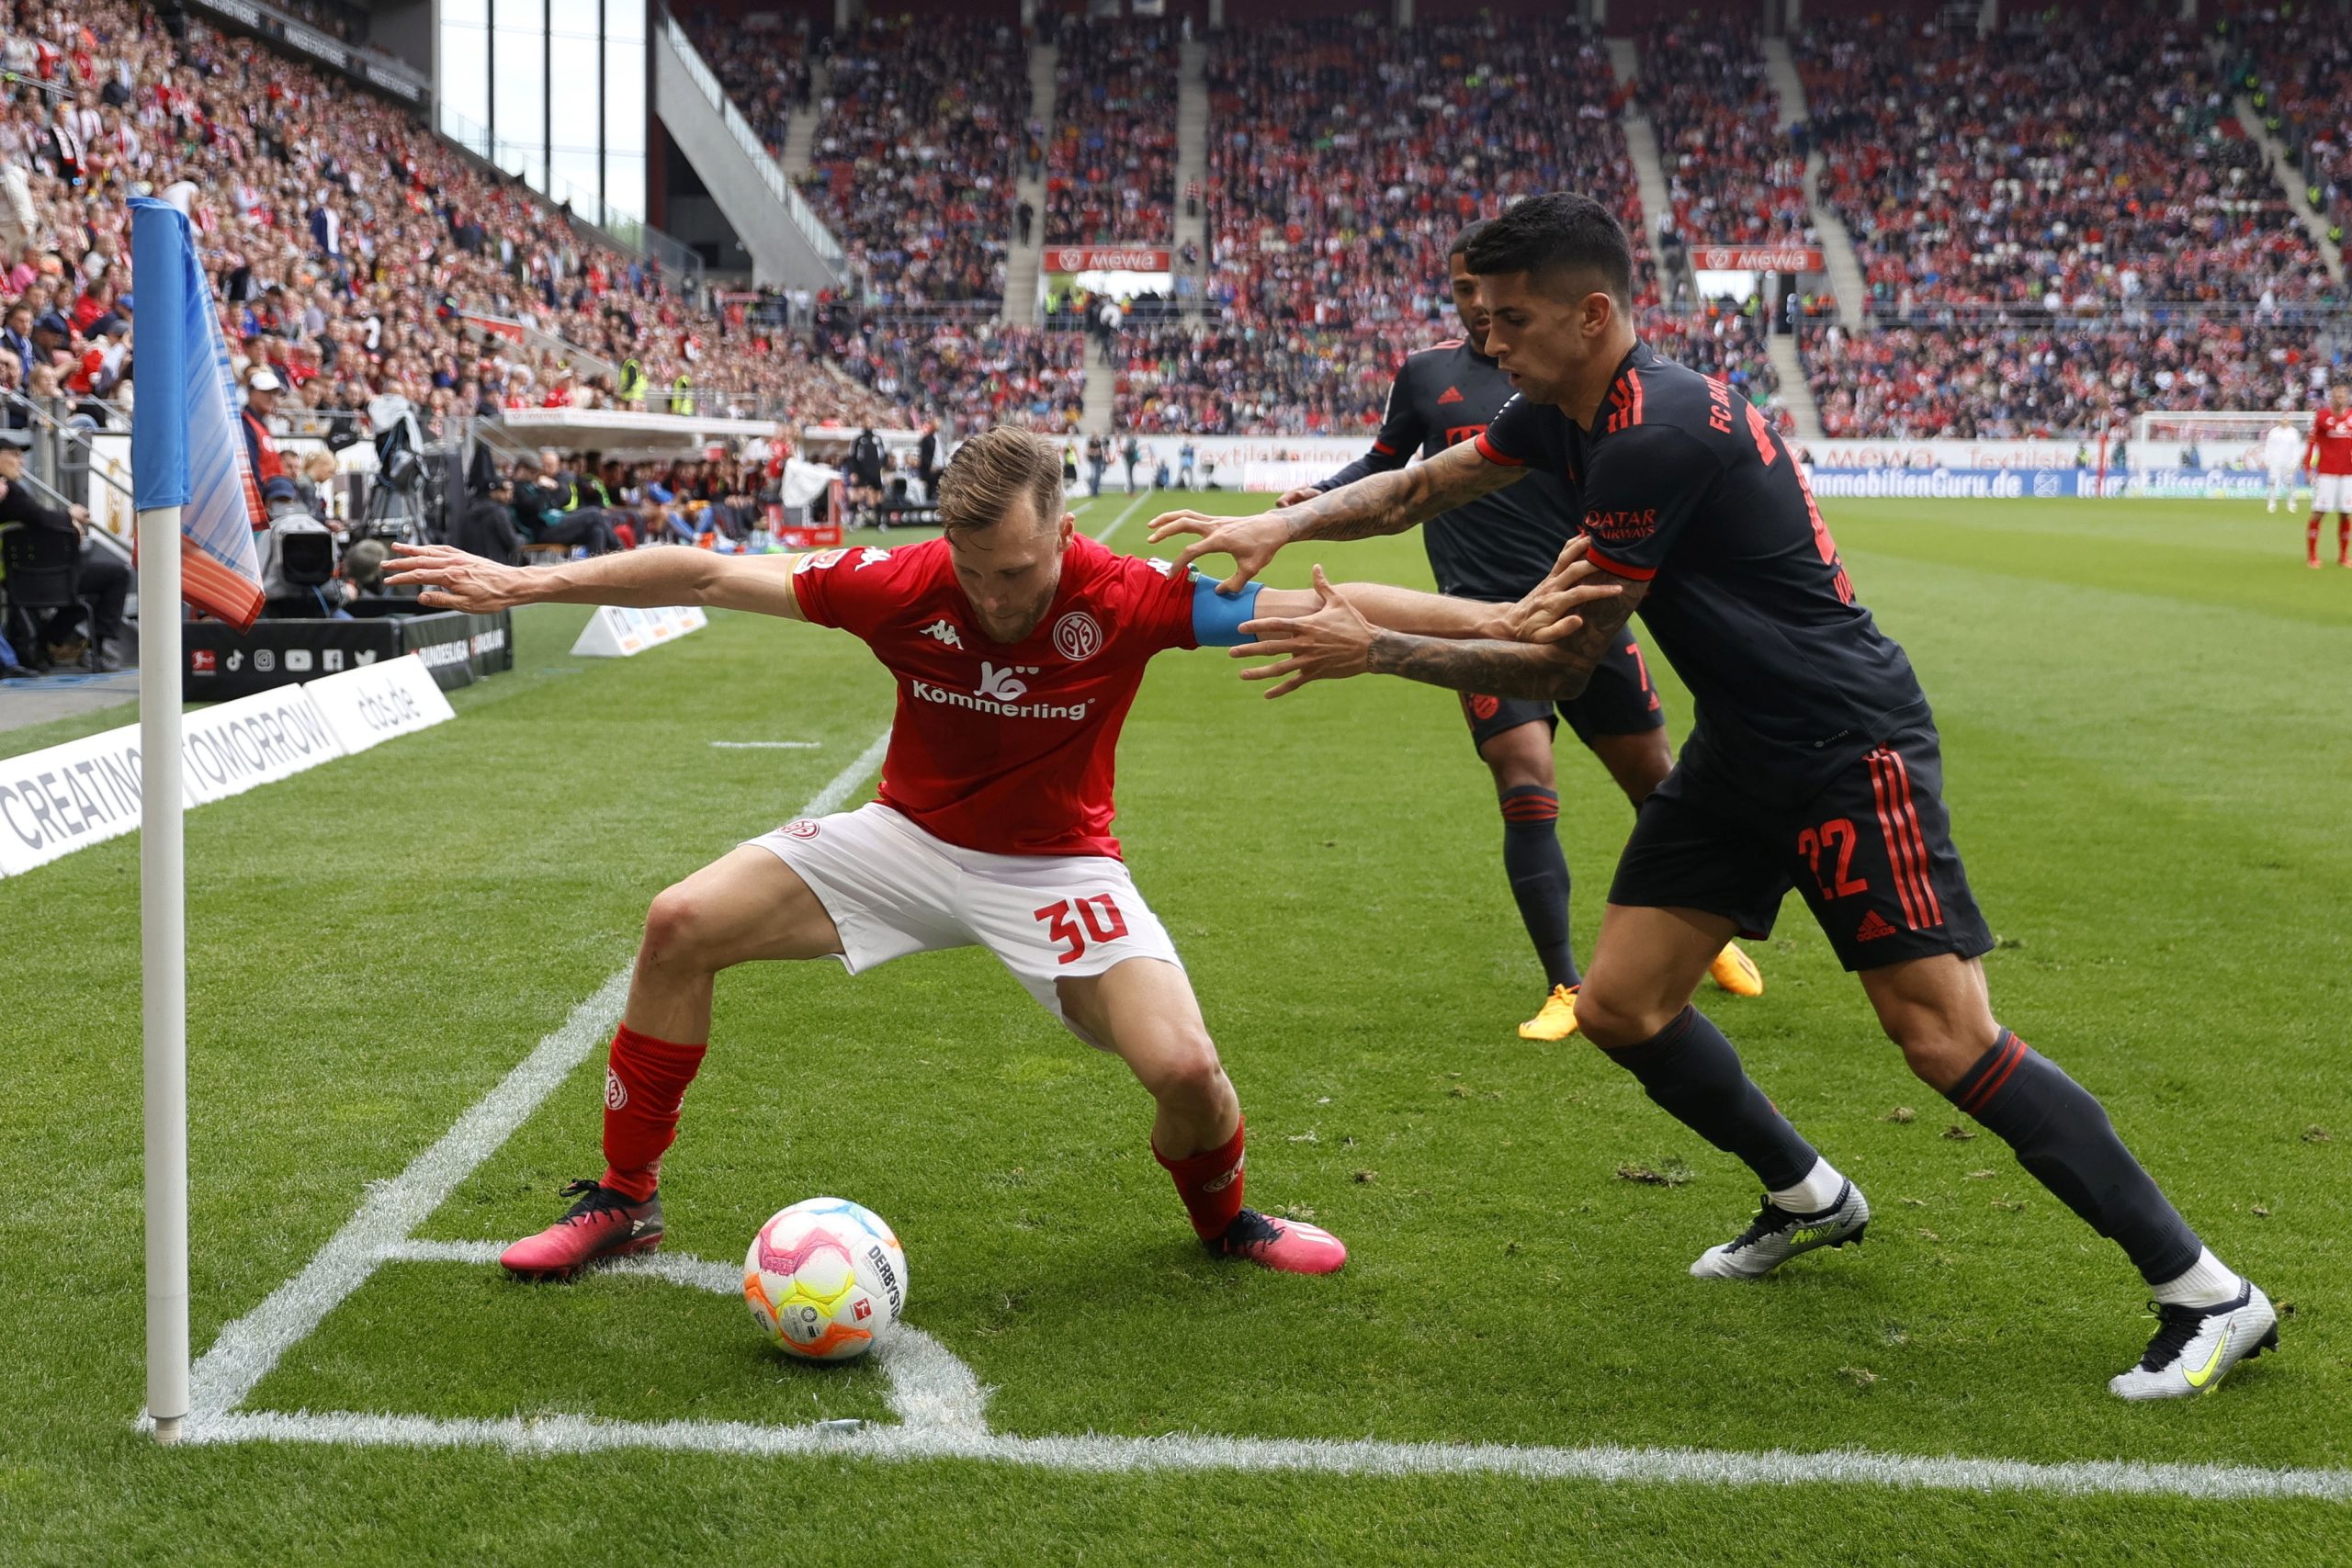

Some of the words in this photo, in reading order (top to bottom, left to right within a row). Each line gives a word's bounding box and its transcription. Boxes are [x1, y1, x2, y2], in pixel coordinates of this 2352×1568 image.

[1709, 404, 1733, 434] FC
[1584, 508, 1657, 529] QATAR
[182, 698, 331, 791] TOMORROW
[1798, 818, 1869, 901] 22
[1033, 893, 1129, 964] 30
